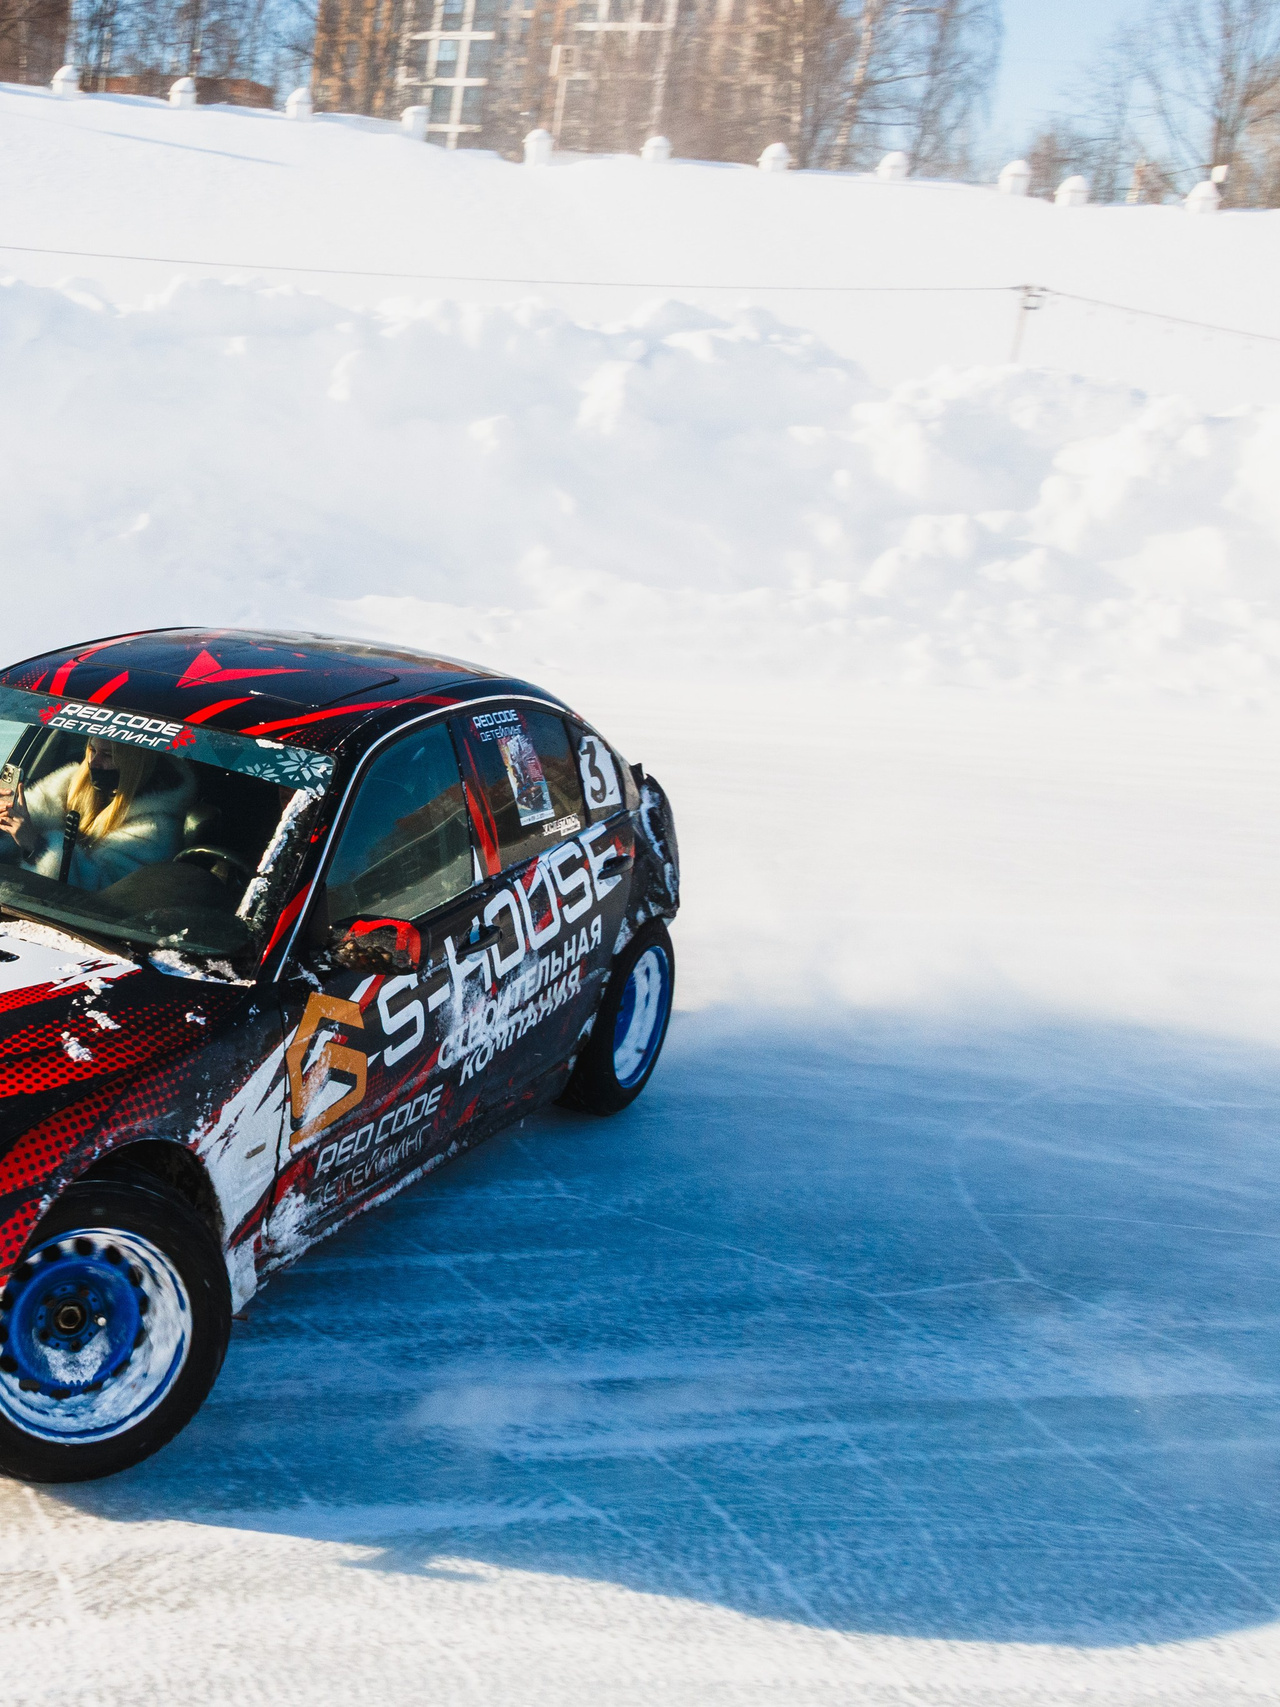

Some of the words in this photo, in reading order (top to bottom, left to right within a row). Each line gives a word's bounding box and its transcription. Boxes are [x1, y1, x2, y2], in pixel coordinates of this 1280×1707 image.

[47, 716, 170, 747] ДЕТЕЙЛИНГ
[61, 704, 115, 723] RED
[111, 713, 184, 737] CODE
[473, 713, 495, 729] RED
[494, 709, 519, 724] CODE
[377, 825, 622, 1067] S-HOUSE
[314, 1122, 375, 1179] RED
[374, 1083, 444, 1144] CODE
